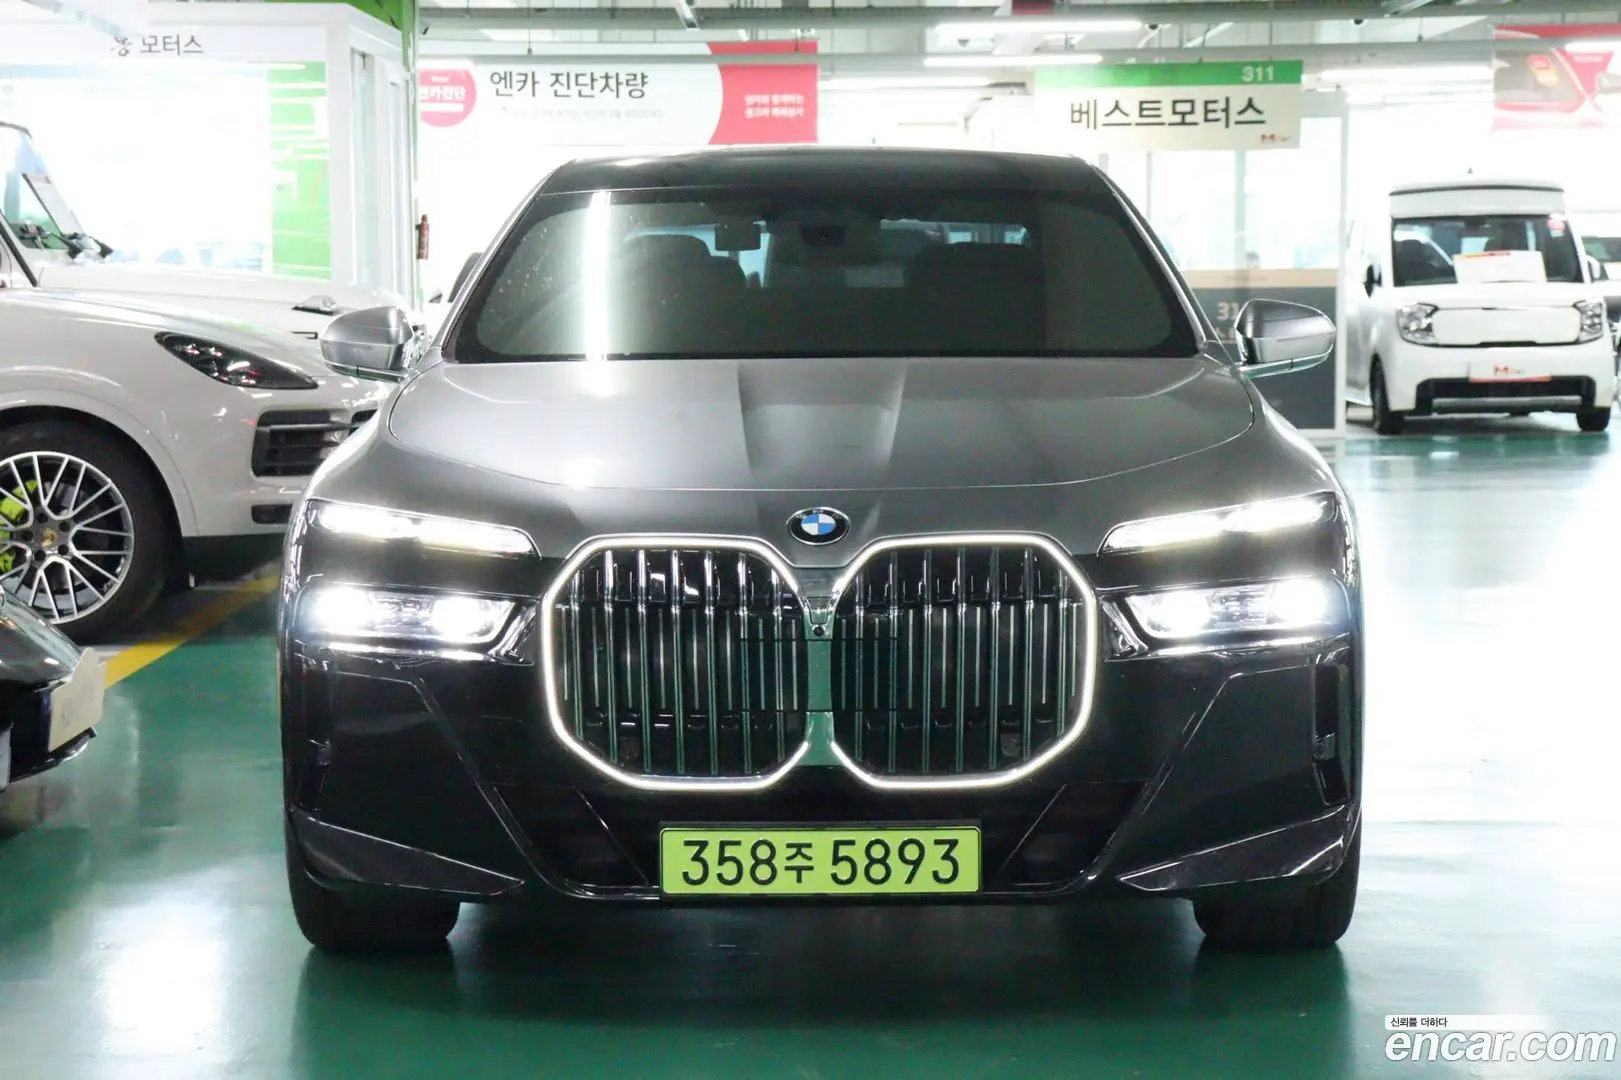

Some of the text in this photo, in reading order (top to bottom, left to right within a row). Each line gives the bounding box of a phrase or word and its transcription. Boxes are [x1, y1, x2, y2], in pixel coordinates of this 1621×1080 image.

[140, 33, 204, 56] 모터스
[490, 70, 649, 99] 엔카 진단차량
[1241, 66, 1274, 82] 311
[1070, 96, 1266, 130] 베스트모터스
[682, 837, 960, 886] 358주 5893
